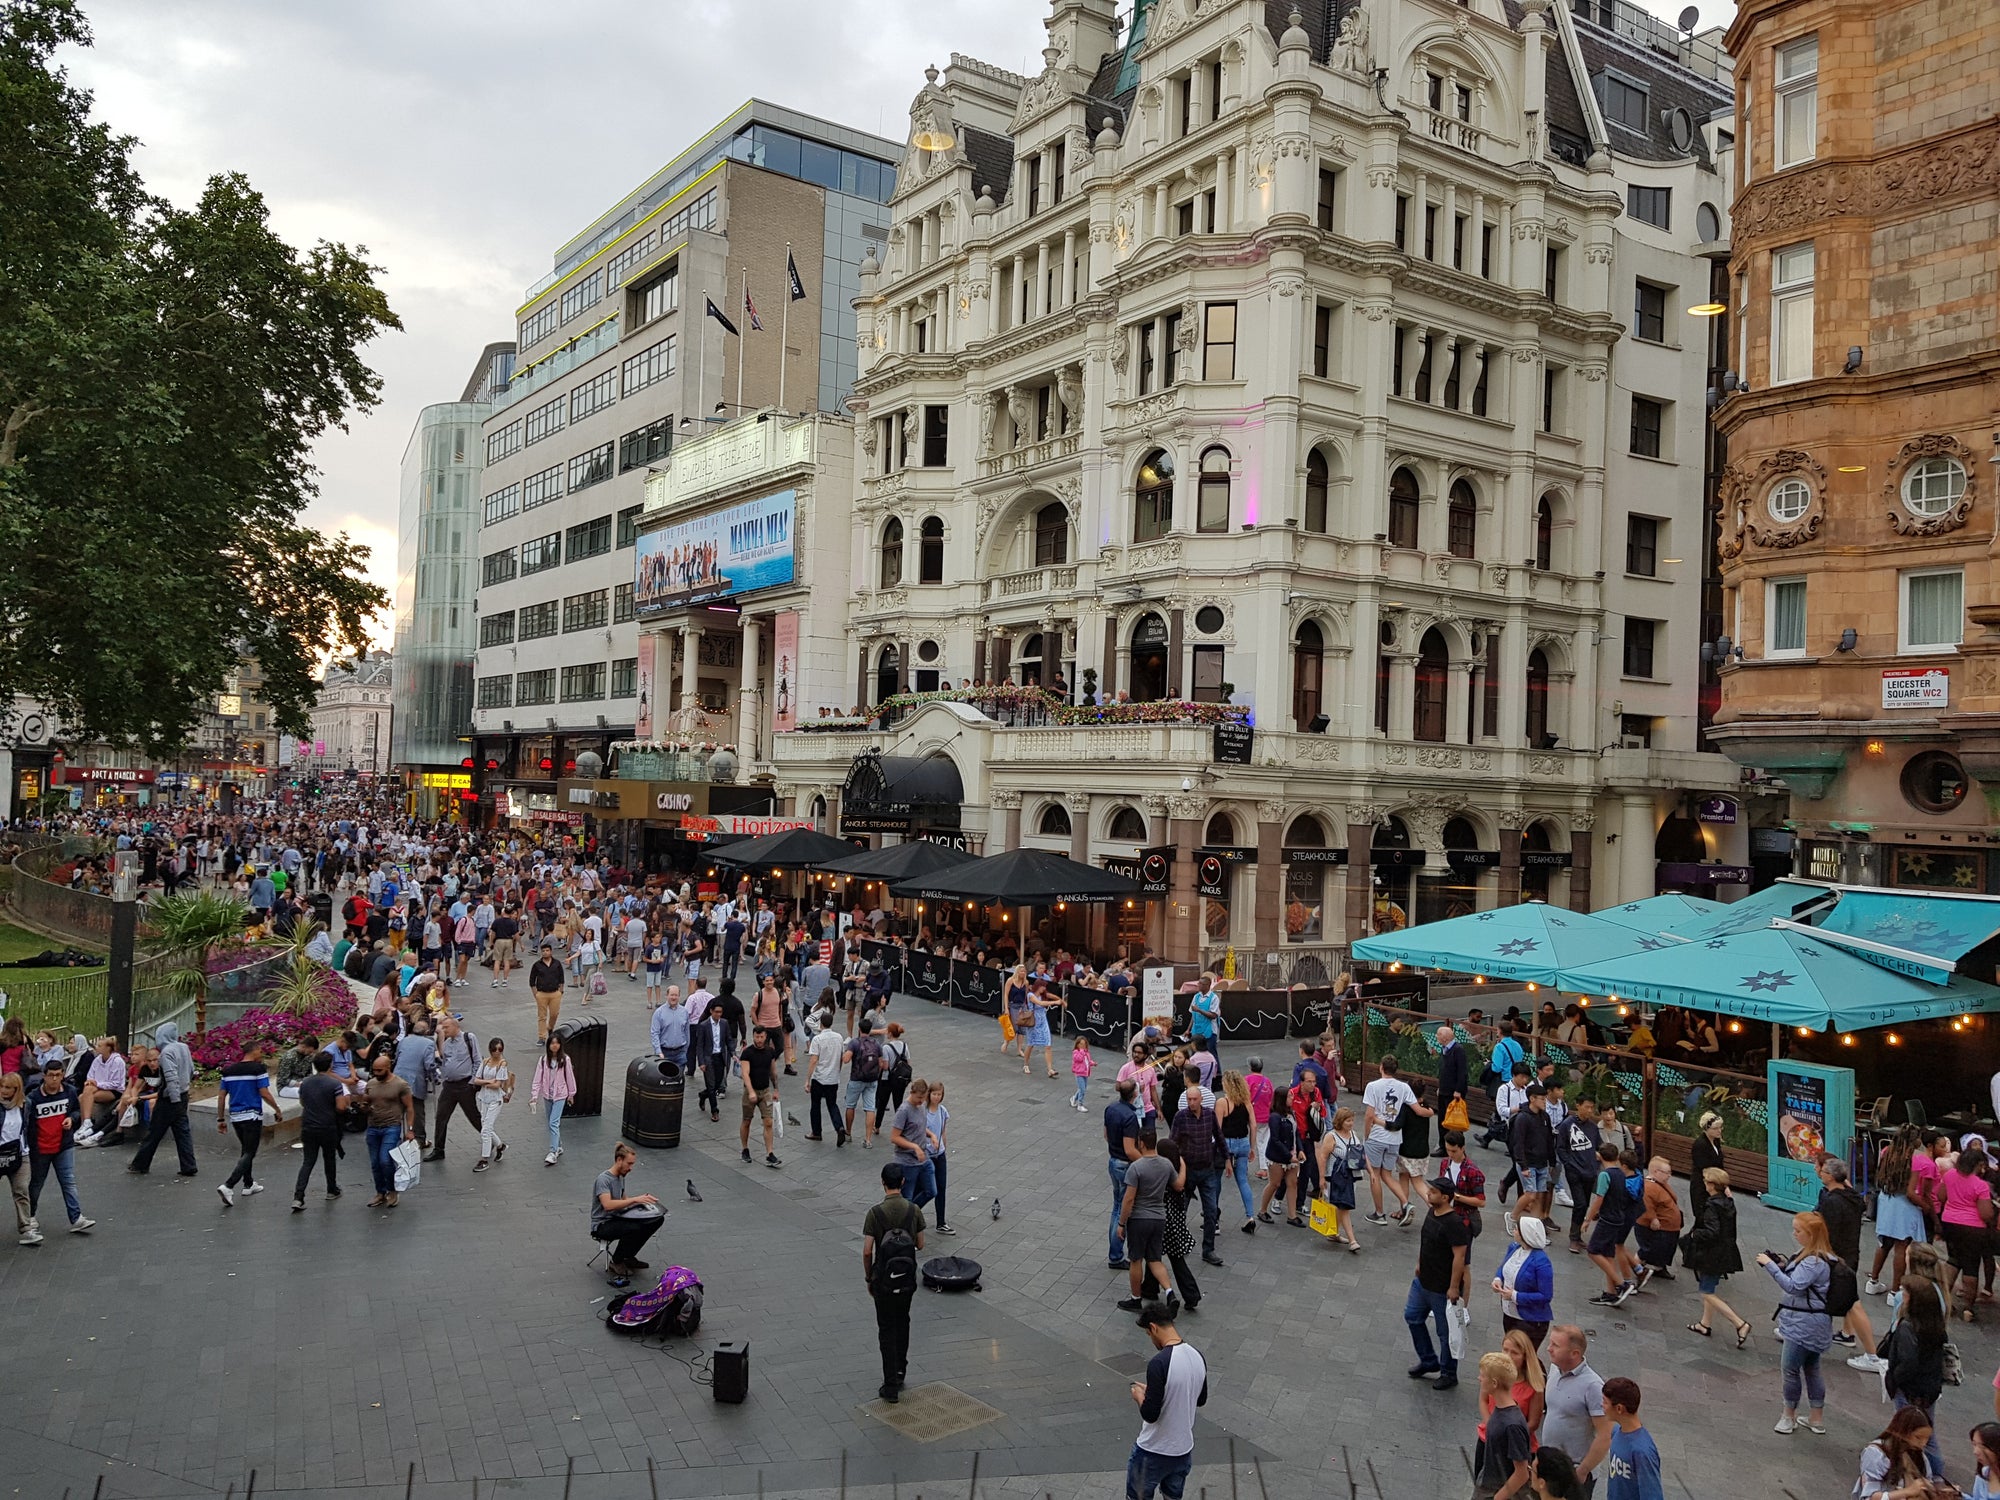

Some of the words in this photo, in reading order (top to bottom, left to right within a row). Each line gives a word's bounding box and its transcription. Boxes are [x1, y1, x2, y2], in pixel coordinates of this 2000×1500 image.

[681, 457, 713, 484] EMPIRE
[718, 440, 761, 471] THEATRE
[660, 529, 674, 542] HAVE
[677, 525, 688, 537] THE
[692, 521, 707, 533] TIME
[712, 517, 719, 527] OF
[723, 510, 740, 522] YOUR
[729, 517, 764, 556] MAMMA
[766, 509, 788, 546] MIA!
[1887, 680, 1931, 689] LEICESTER
[1887, 689, 1920, 698] SQUARE
[1923, 688, 1942, 697] WC2
[91, 770, 107, 779] PRET
[108, 771, 113, 780] A
[114, 771, 136, 780] MANGER
[845, 757, 868, 790] QUEEN'S
[869, 759, 887, 791] HOUSE
[657, 793, 692, 810] CASINO
[539, 812, 552, 820] SALE
[557, 812, 567, 821] SAL
[1700, 813, 1722, 821] Premier
[1724, 813, 1735, 821] Inn
[732, 818, 814, 835] Horizons
[1225, 851, 1243, 860] GUS
[1293, 852, 1337, 861] STEAKHOUSE
[1464, 855, 1486, 863] ANGUS
[1527, 856, 1564, 864] STEAKHOUSE
[1108, 865, 1140, 880] ANGU
[926, 890, 943, 898] ANGUS
[1200, 886, 1221, 895] ANGUS
[1064, 894, 1088, 902] ANGUS
[1866, 952, 1925, 977] KITCHEN
[1600, 982, 1662, 1001] MAISON
[1679, 992, 1697, 1006] DU
[1087, 1011, 1104, 1021] ANGUS
[1786, 1097, 1823, 1114] TASTE
[1791, 1111, 1817, 1121] UNDERSTAND
